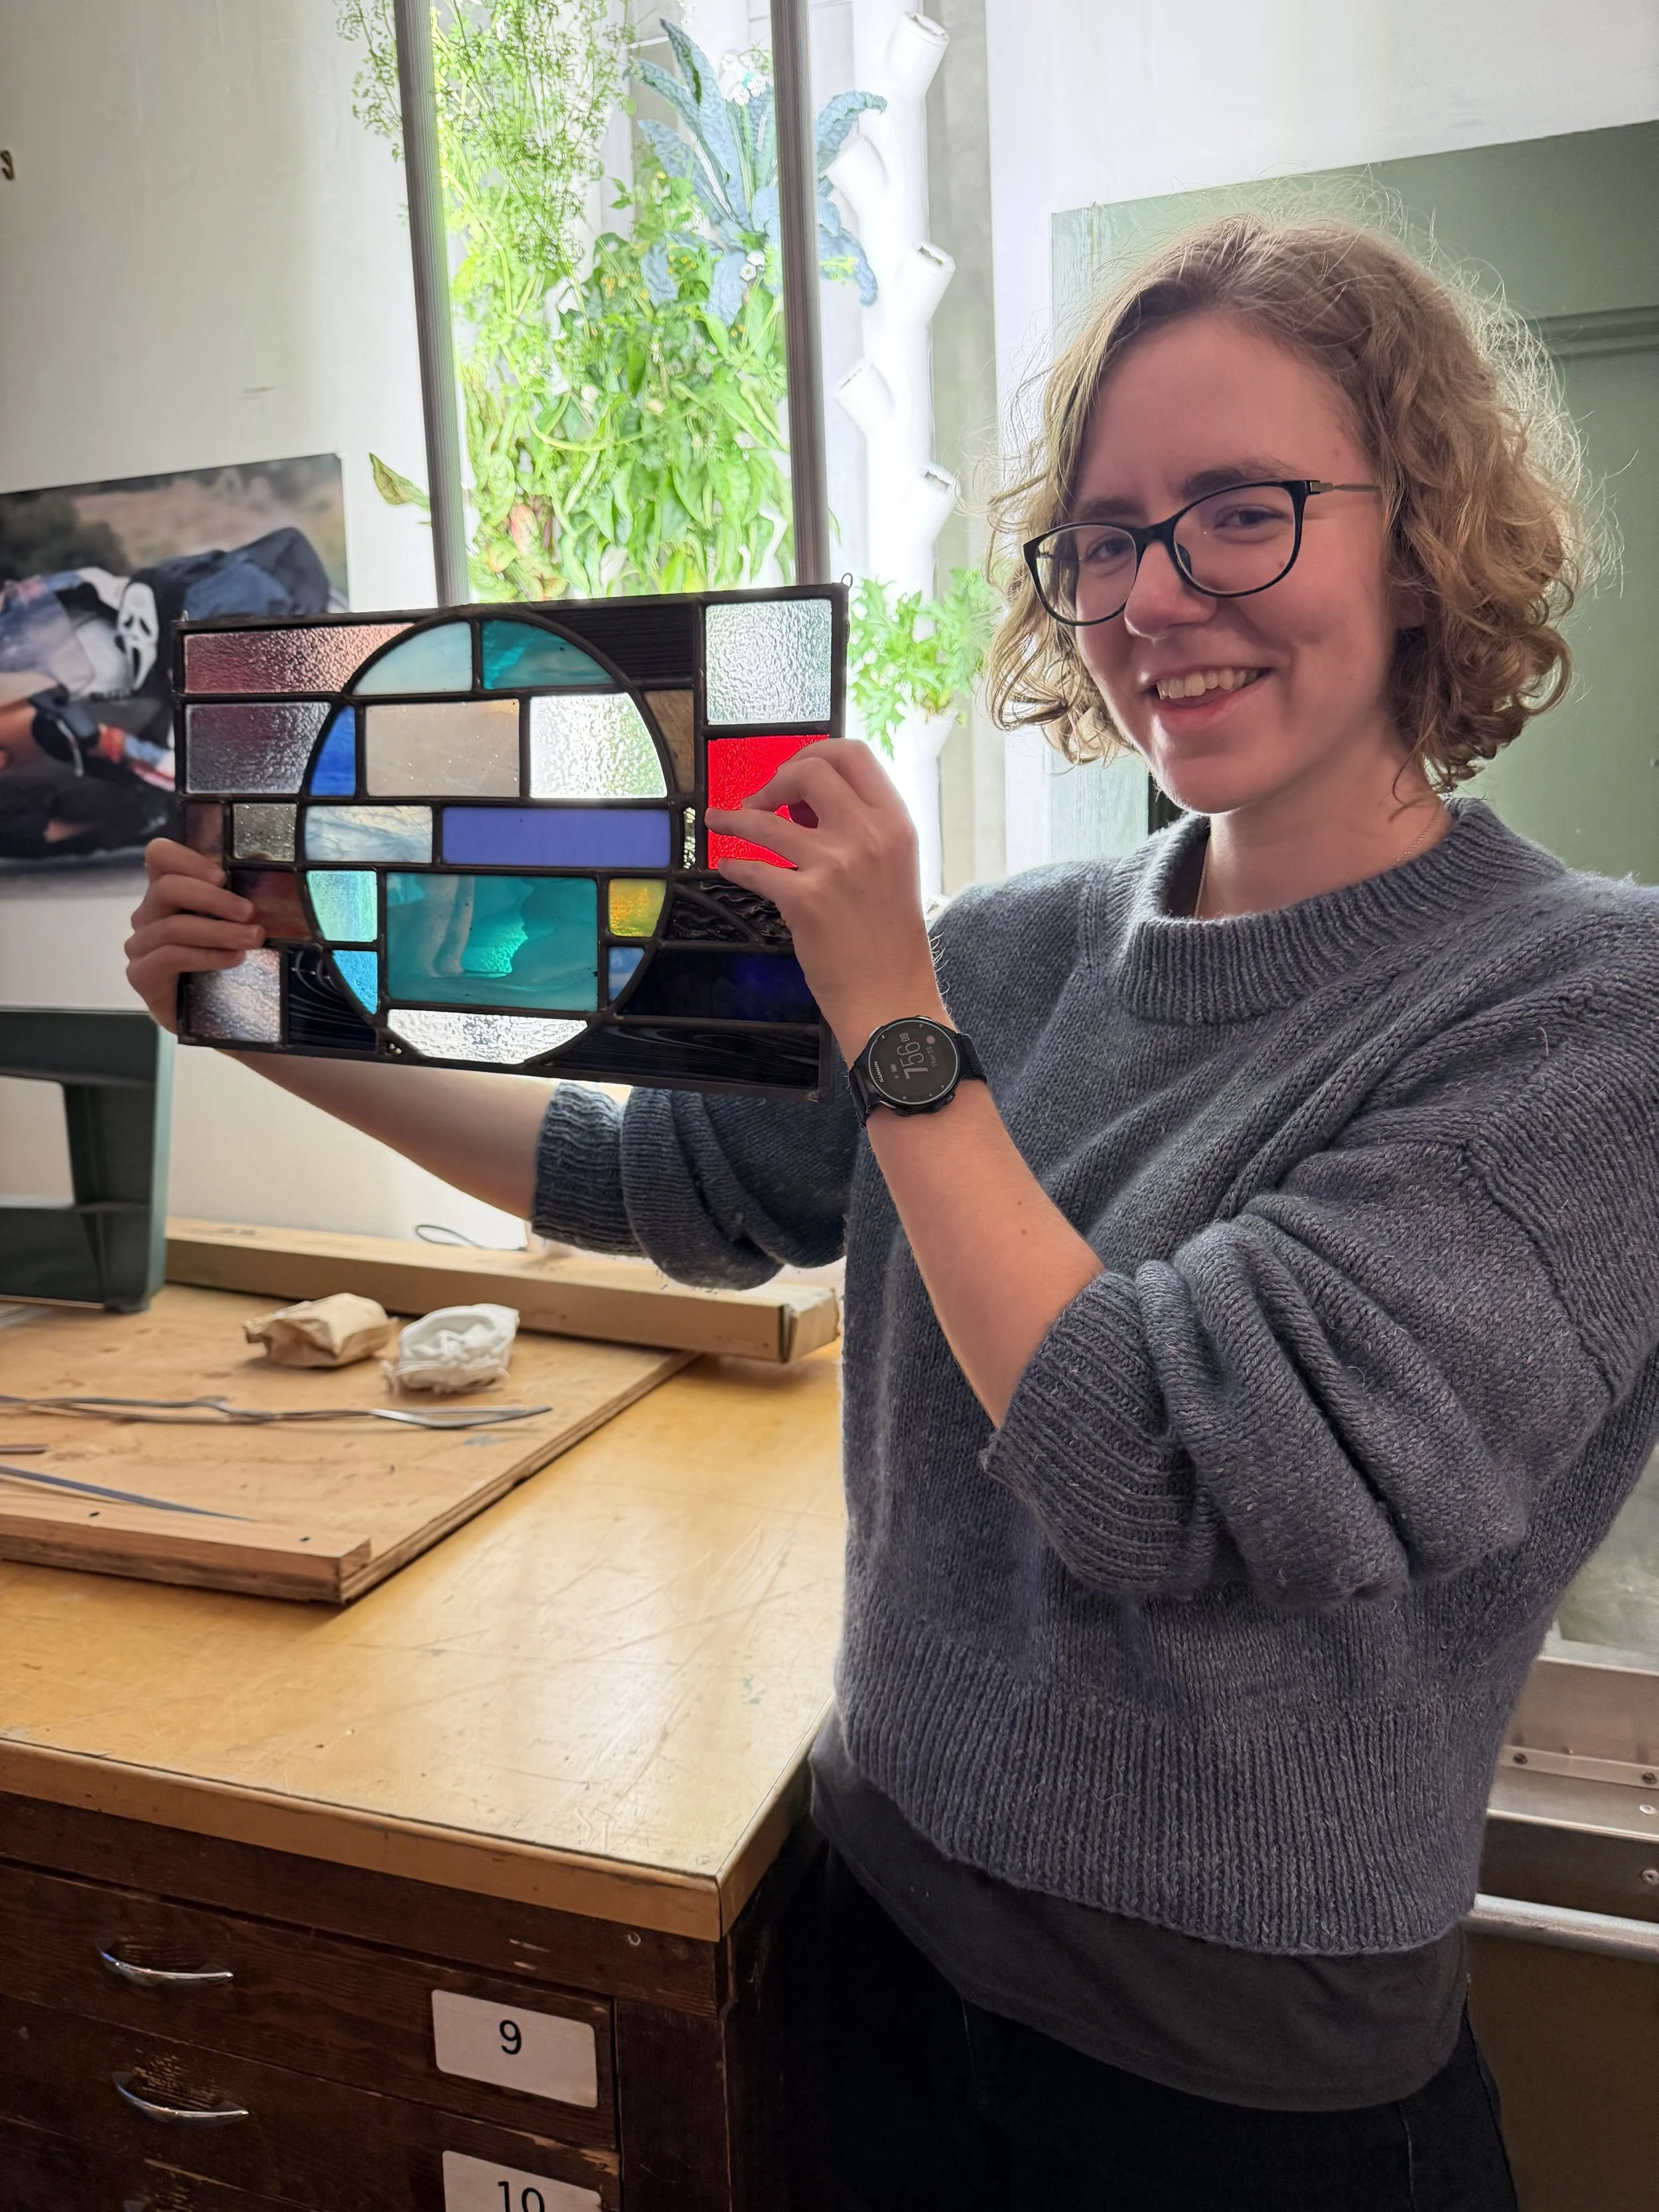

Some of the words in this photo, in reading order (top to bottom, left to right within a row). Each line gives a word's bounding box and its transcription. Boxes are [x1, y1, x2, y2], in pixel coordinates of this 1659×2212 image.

[873, 1062, 883, 1082] GARMIN
[499, 2020, 522, 2055] 9
[498, 2181, 545, 2212] 10
